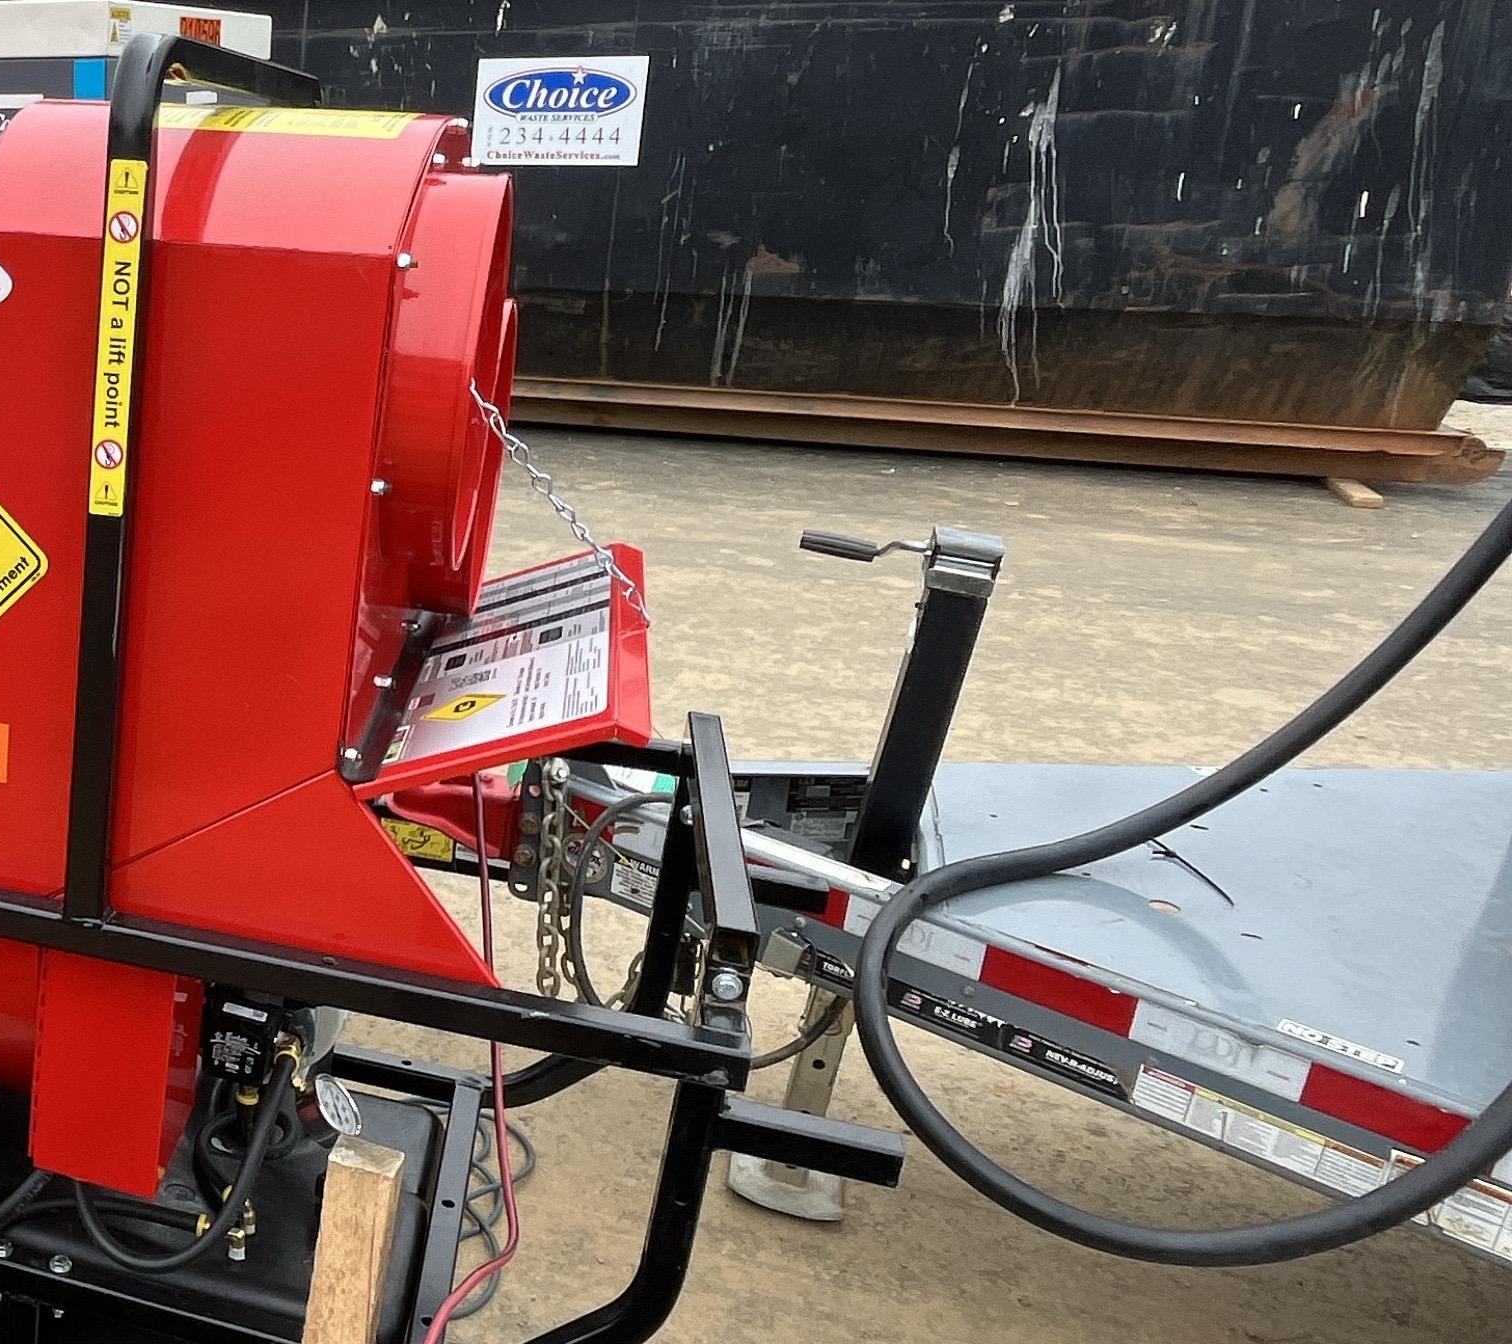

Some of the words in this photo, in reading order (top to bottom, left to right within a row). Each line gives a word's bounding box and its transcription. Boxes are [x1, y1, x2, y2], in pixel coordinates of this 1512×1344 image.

[501, 78, 618, 109] Choice
[519, 113, 549, 122] WASTE
[551, 113, 596, 122] SERVICES
[111, 260, 133, 312] NOT
[110, 316, 124, 330] a
[107, 336, 127, 365] lift
[103, 371, 123, 428] point
[1282, 1021, 1321, 1045] NO
[1327, 1036, 1401, 1071] STEP
